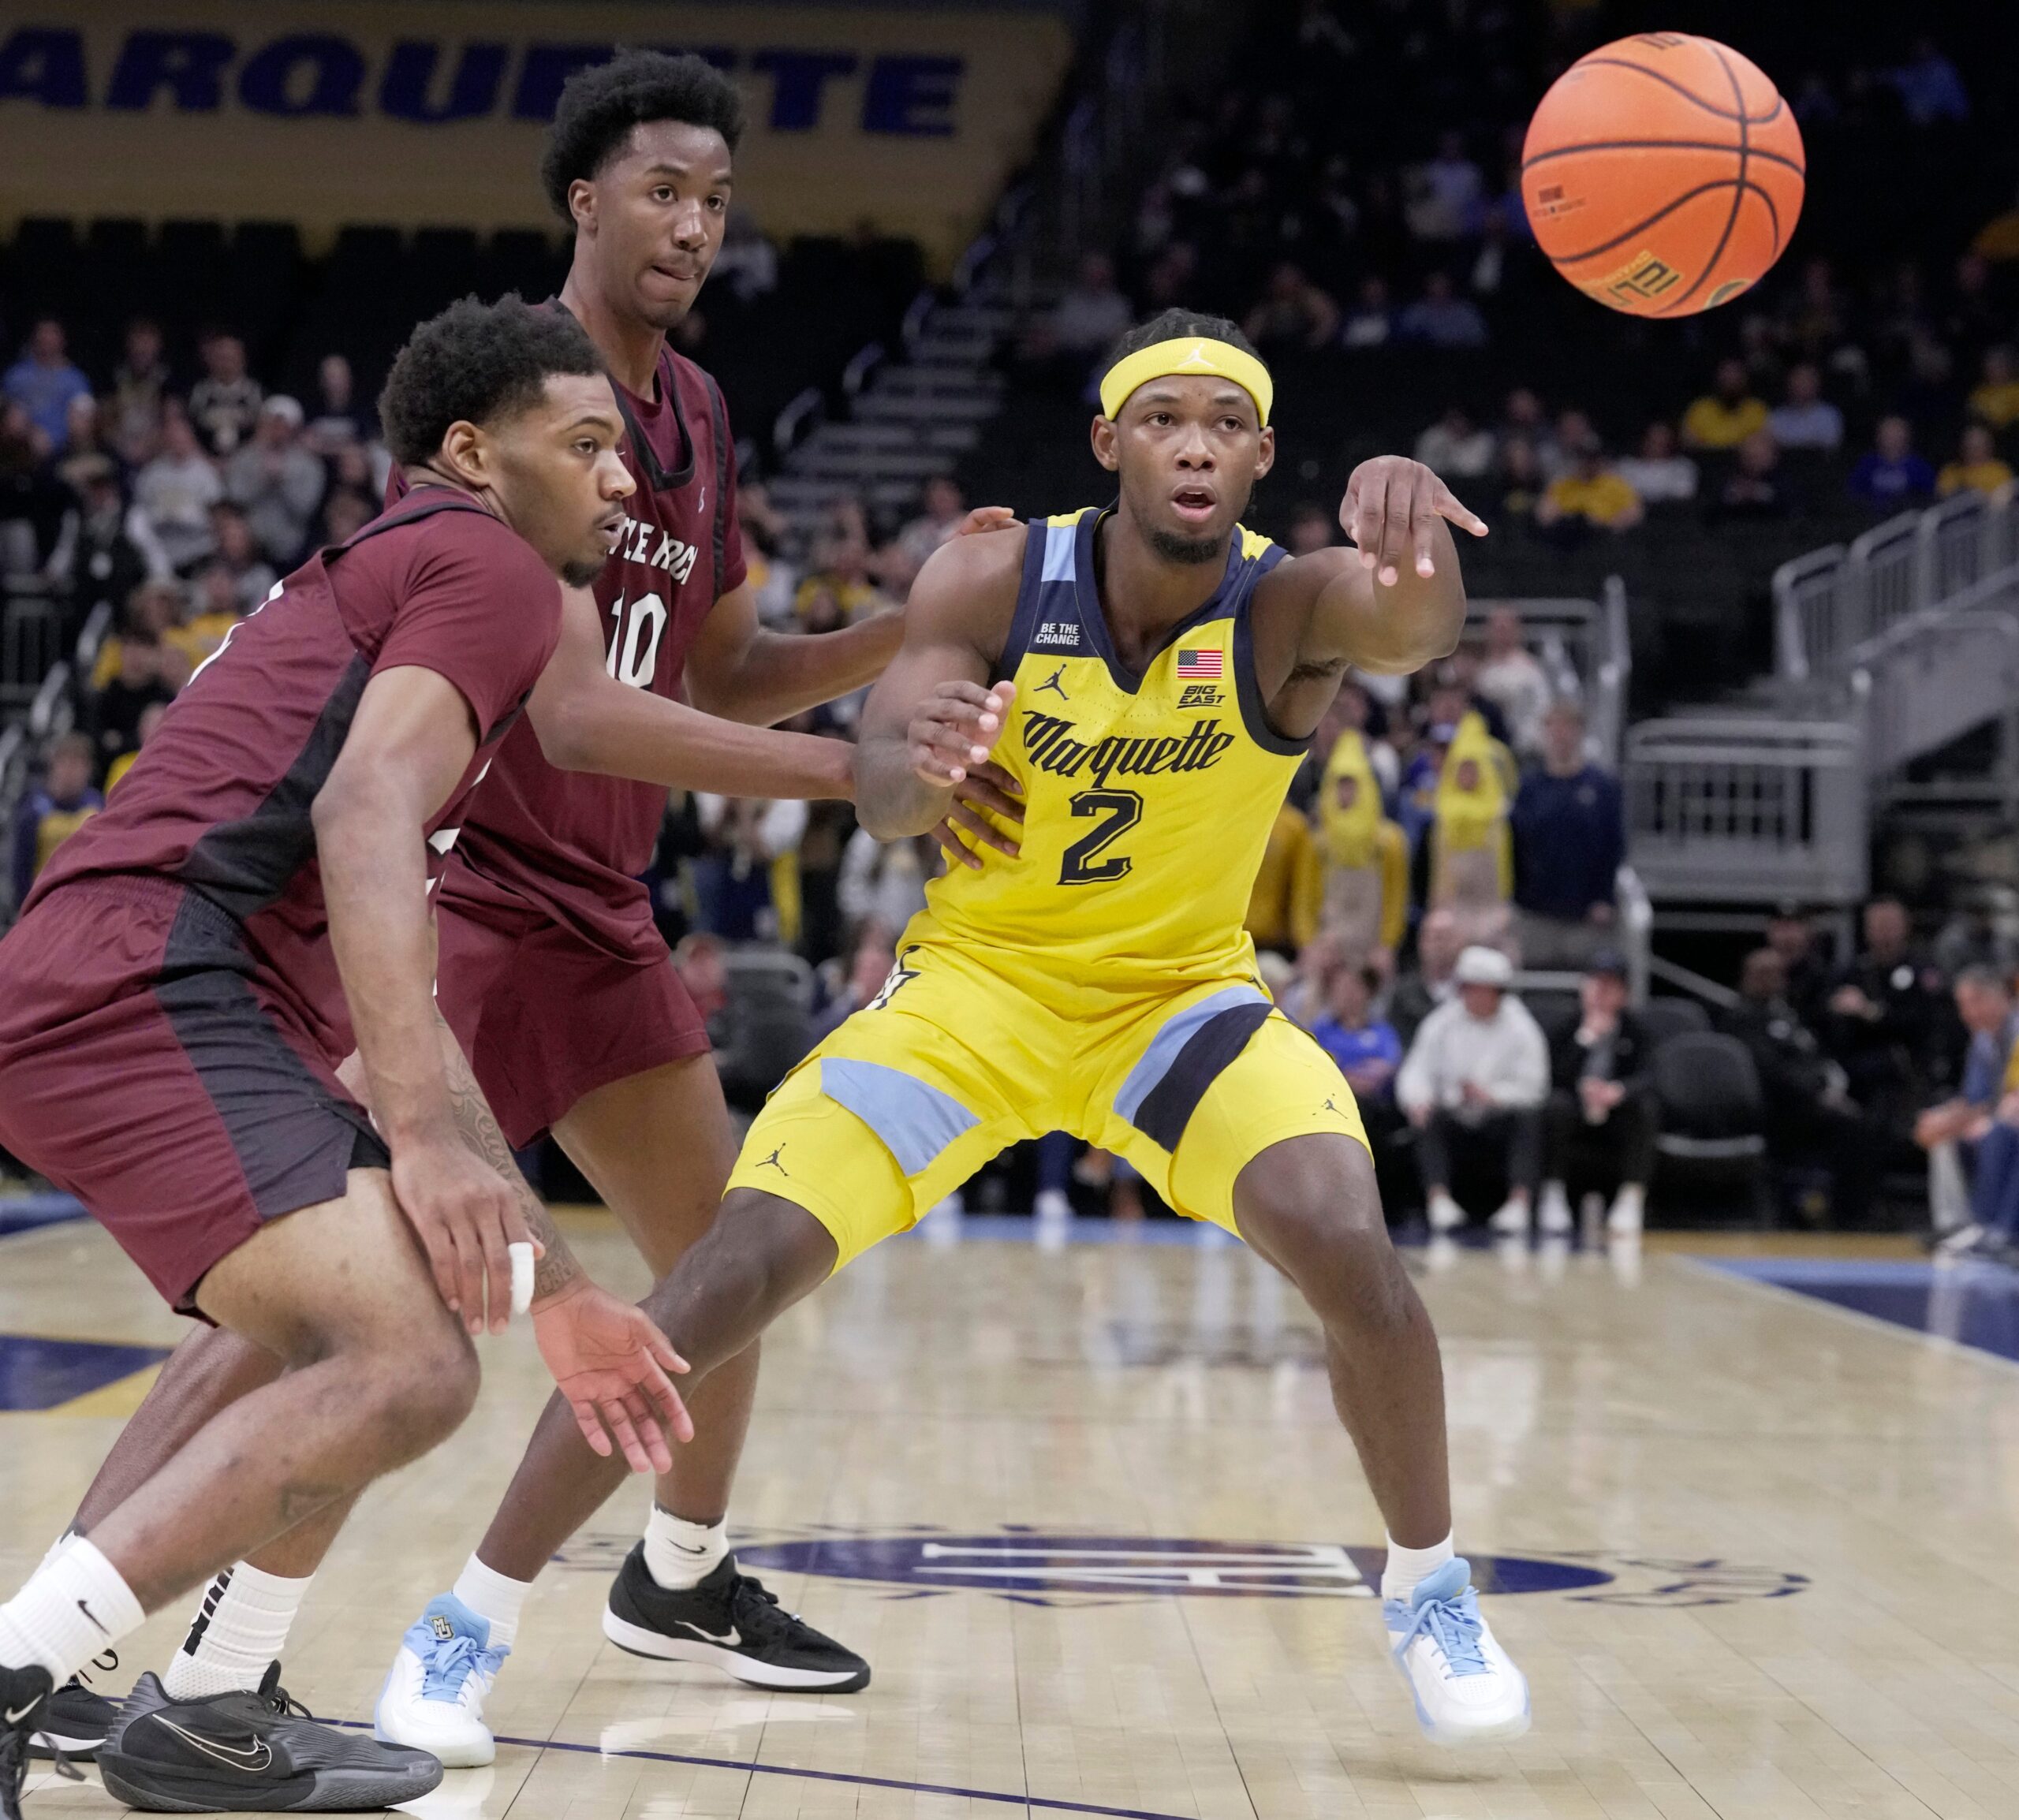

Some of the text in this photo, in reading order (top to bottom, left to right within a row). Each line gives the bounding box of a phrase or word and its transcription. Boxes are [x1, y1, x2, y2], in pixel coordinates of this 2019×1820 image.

[606, 587, 668, 688] 10
[1040, 623, 1080, 635] BE THE
[1035, 633, 1080, 646] CHANGE
[1184, 685, 1218, 695] BIG
[1178, 695, 1226, 704] EAST
[1022, 710, 1236, 789] Marquette
[1056, 788, 1144, 886] 2
[431, 1617, 454, 1639] MU
